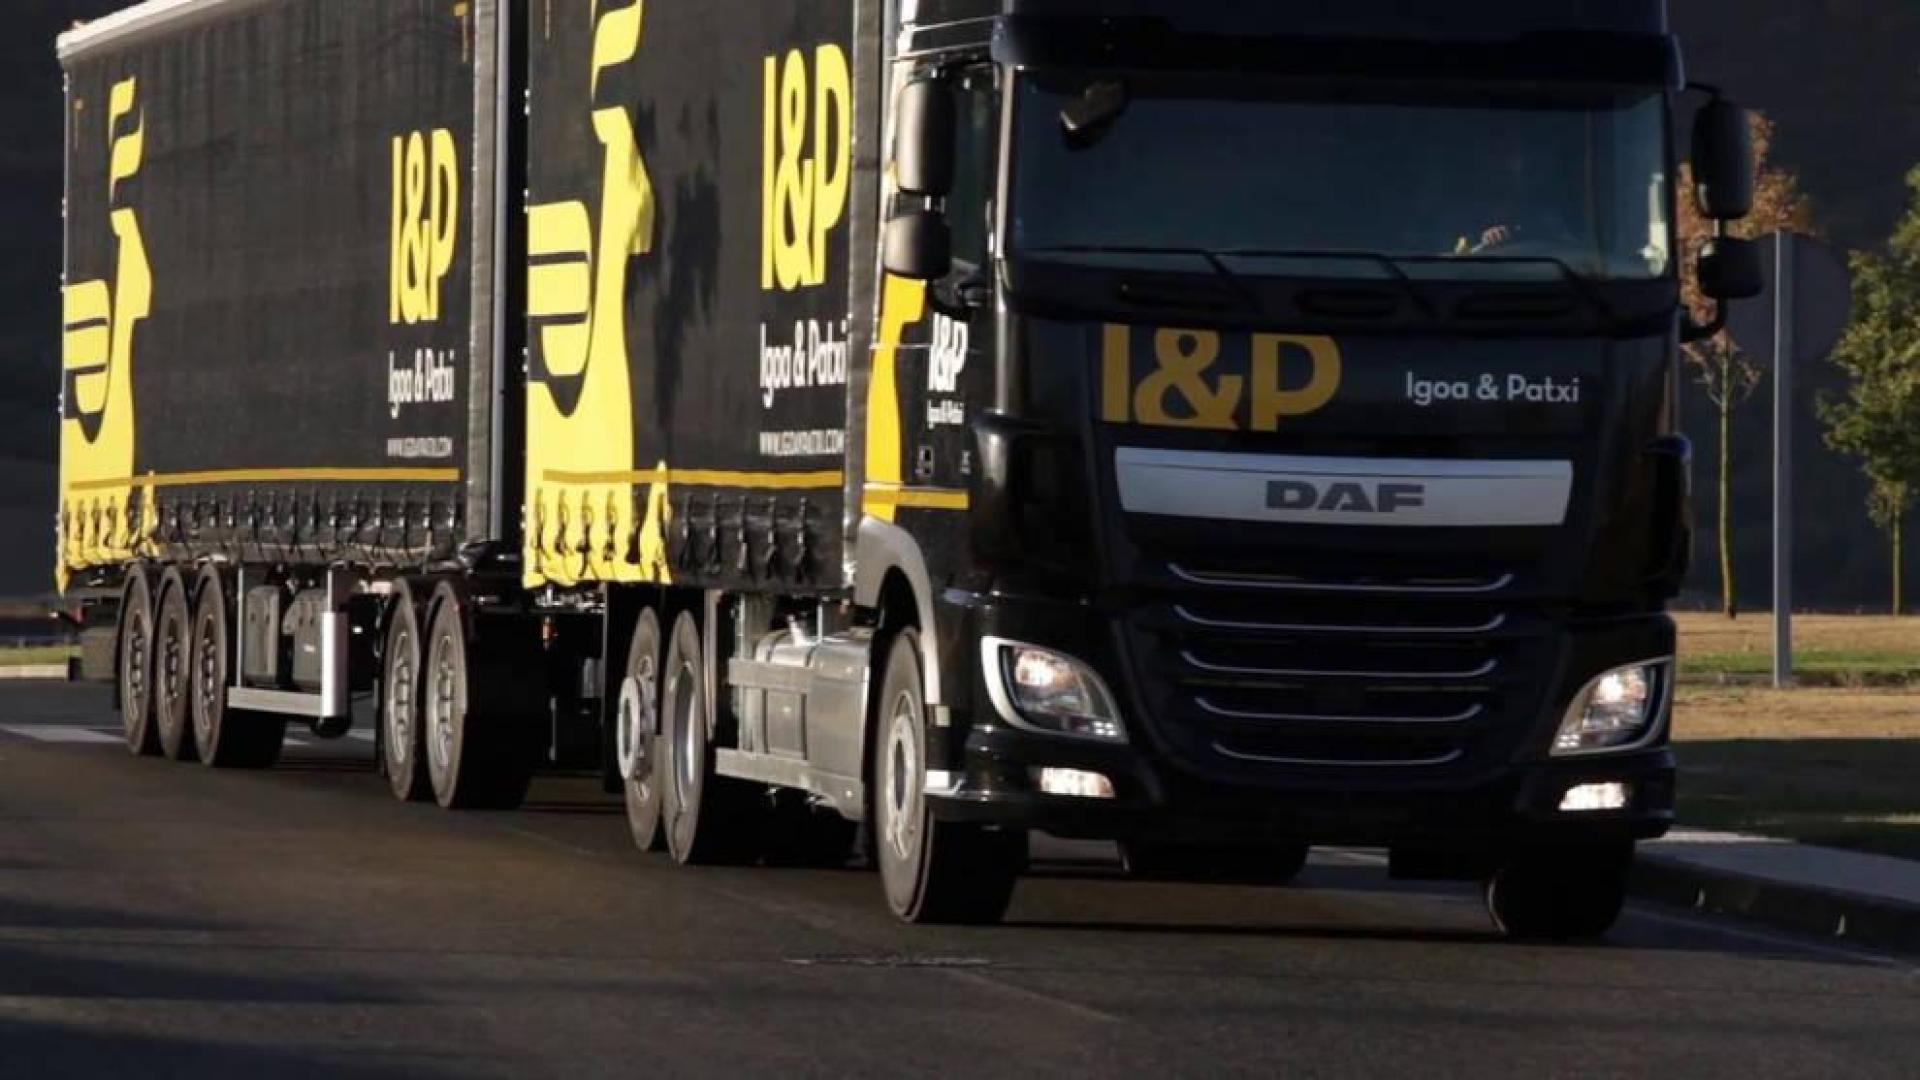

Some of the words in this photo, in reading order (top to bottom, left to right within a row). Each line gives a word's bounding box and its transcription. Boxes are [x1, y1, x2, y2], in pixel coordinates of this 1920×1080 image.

[761, 43, 850, 291] I&P
[390, 128, 457, 323] I&P
[760, 323, 792, 408] Igoa
[928, 312, 968, 392] I&P
[1102, 323, 1342, 432] I&P
[1406, 371, 1469, 406] Igoa
[1477, 374, 1499, 400] &
[1508, 374, 1580, 403] Patxi
[1266, 480, 1425, 512] DAF
